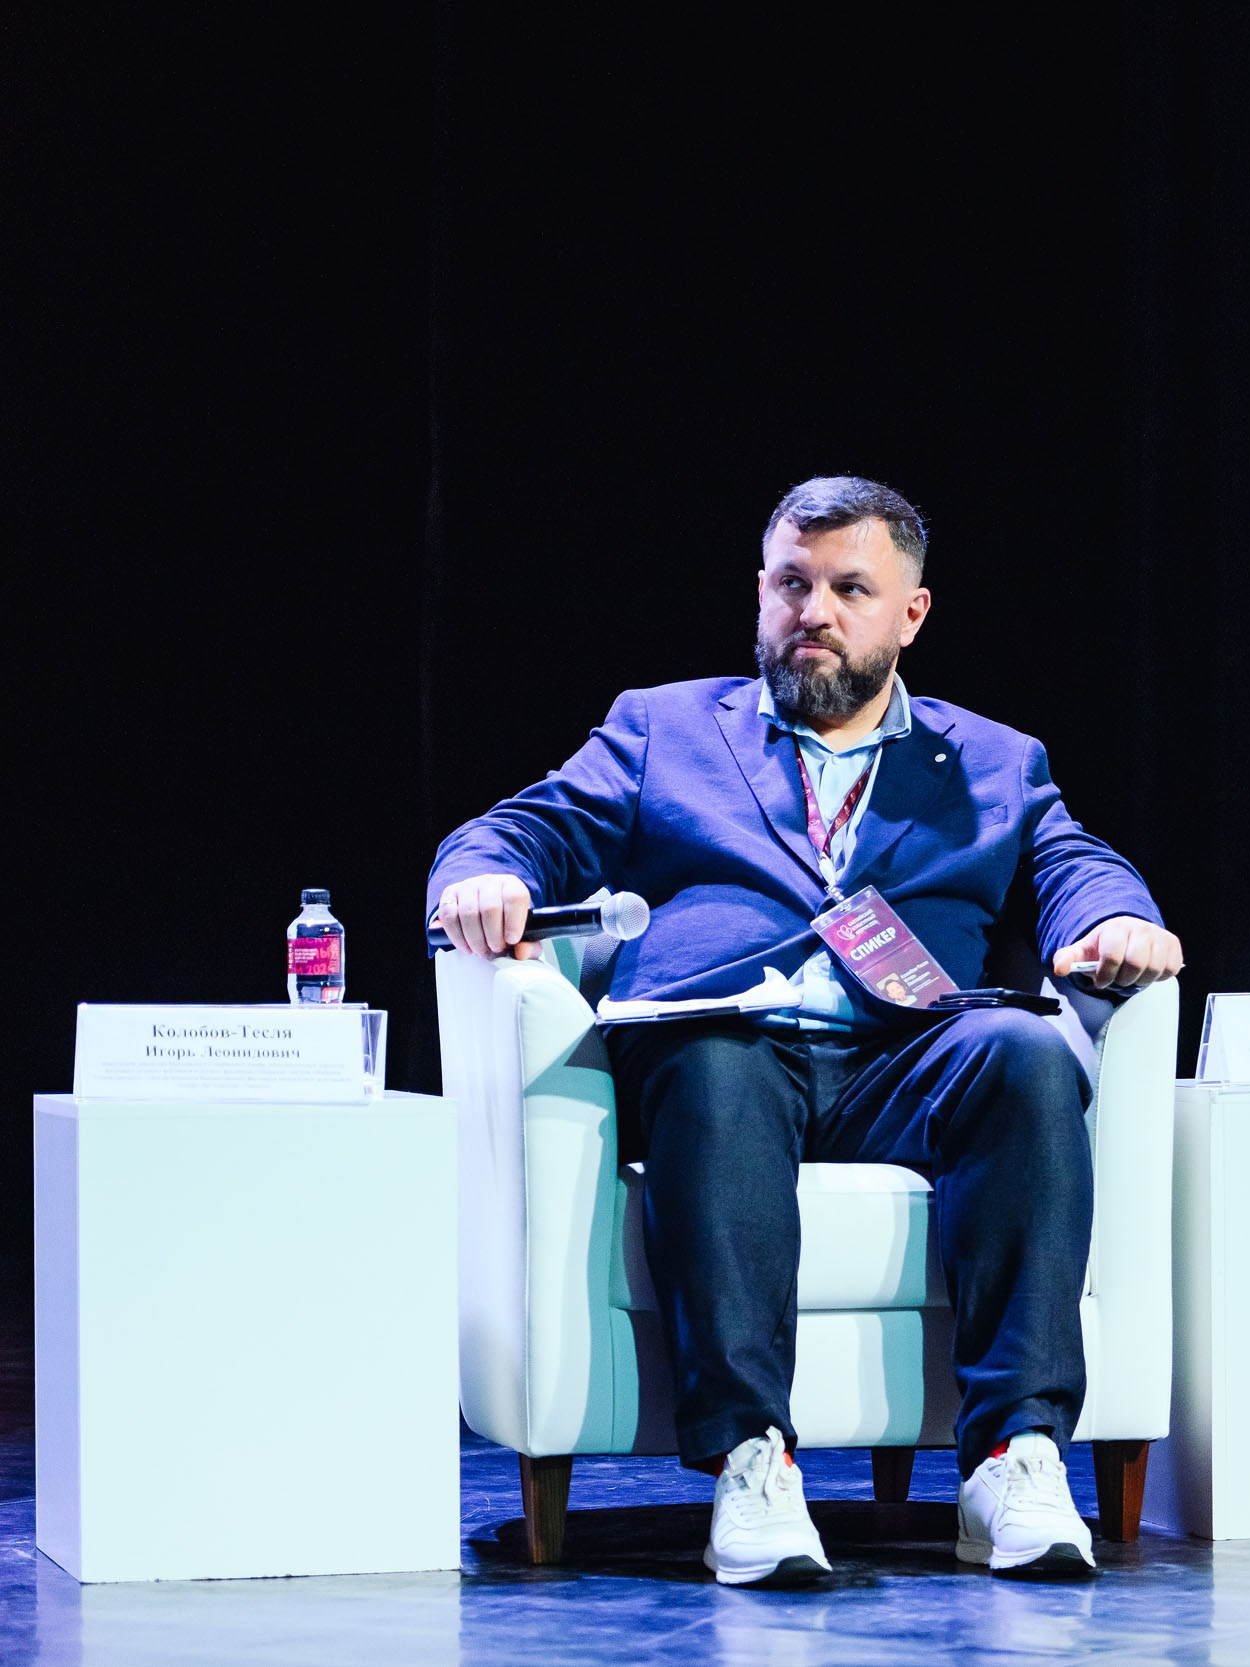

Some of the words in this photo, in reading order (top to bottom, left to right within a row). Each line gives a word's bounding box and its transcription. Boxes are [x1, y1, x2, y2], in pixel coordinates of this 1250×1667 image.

[850, 926, 896, 961] СПИКЕР
[152, 1023, 292, 1039] Колобов-Тесля
[145, 1045, 196, 1060] Игорь
[200, 1045, 301, 1060] Леонидович
